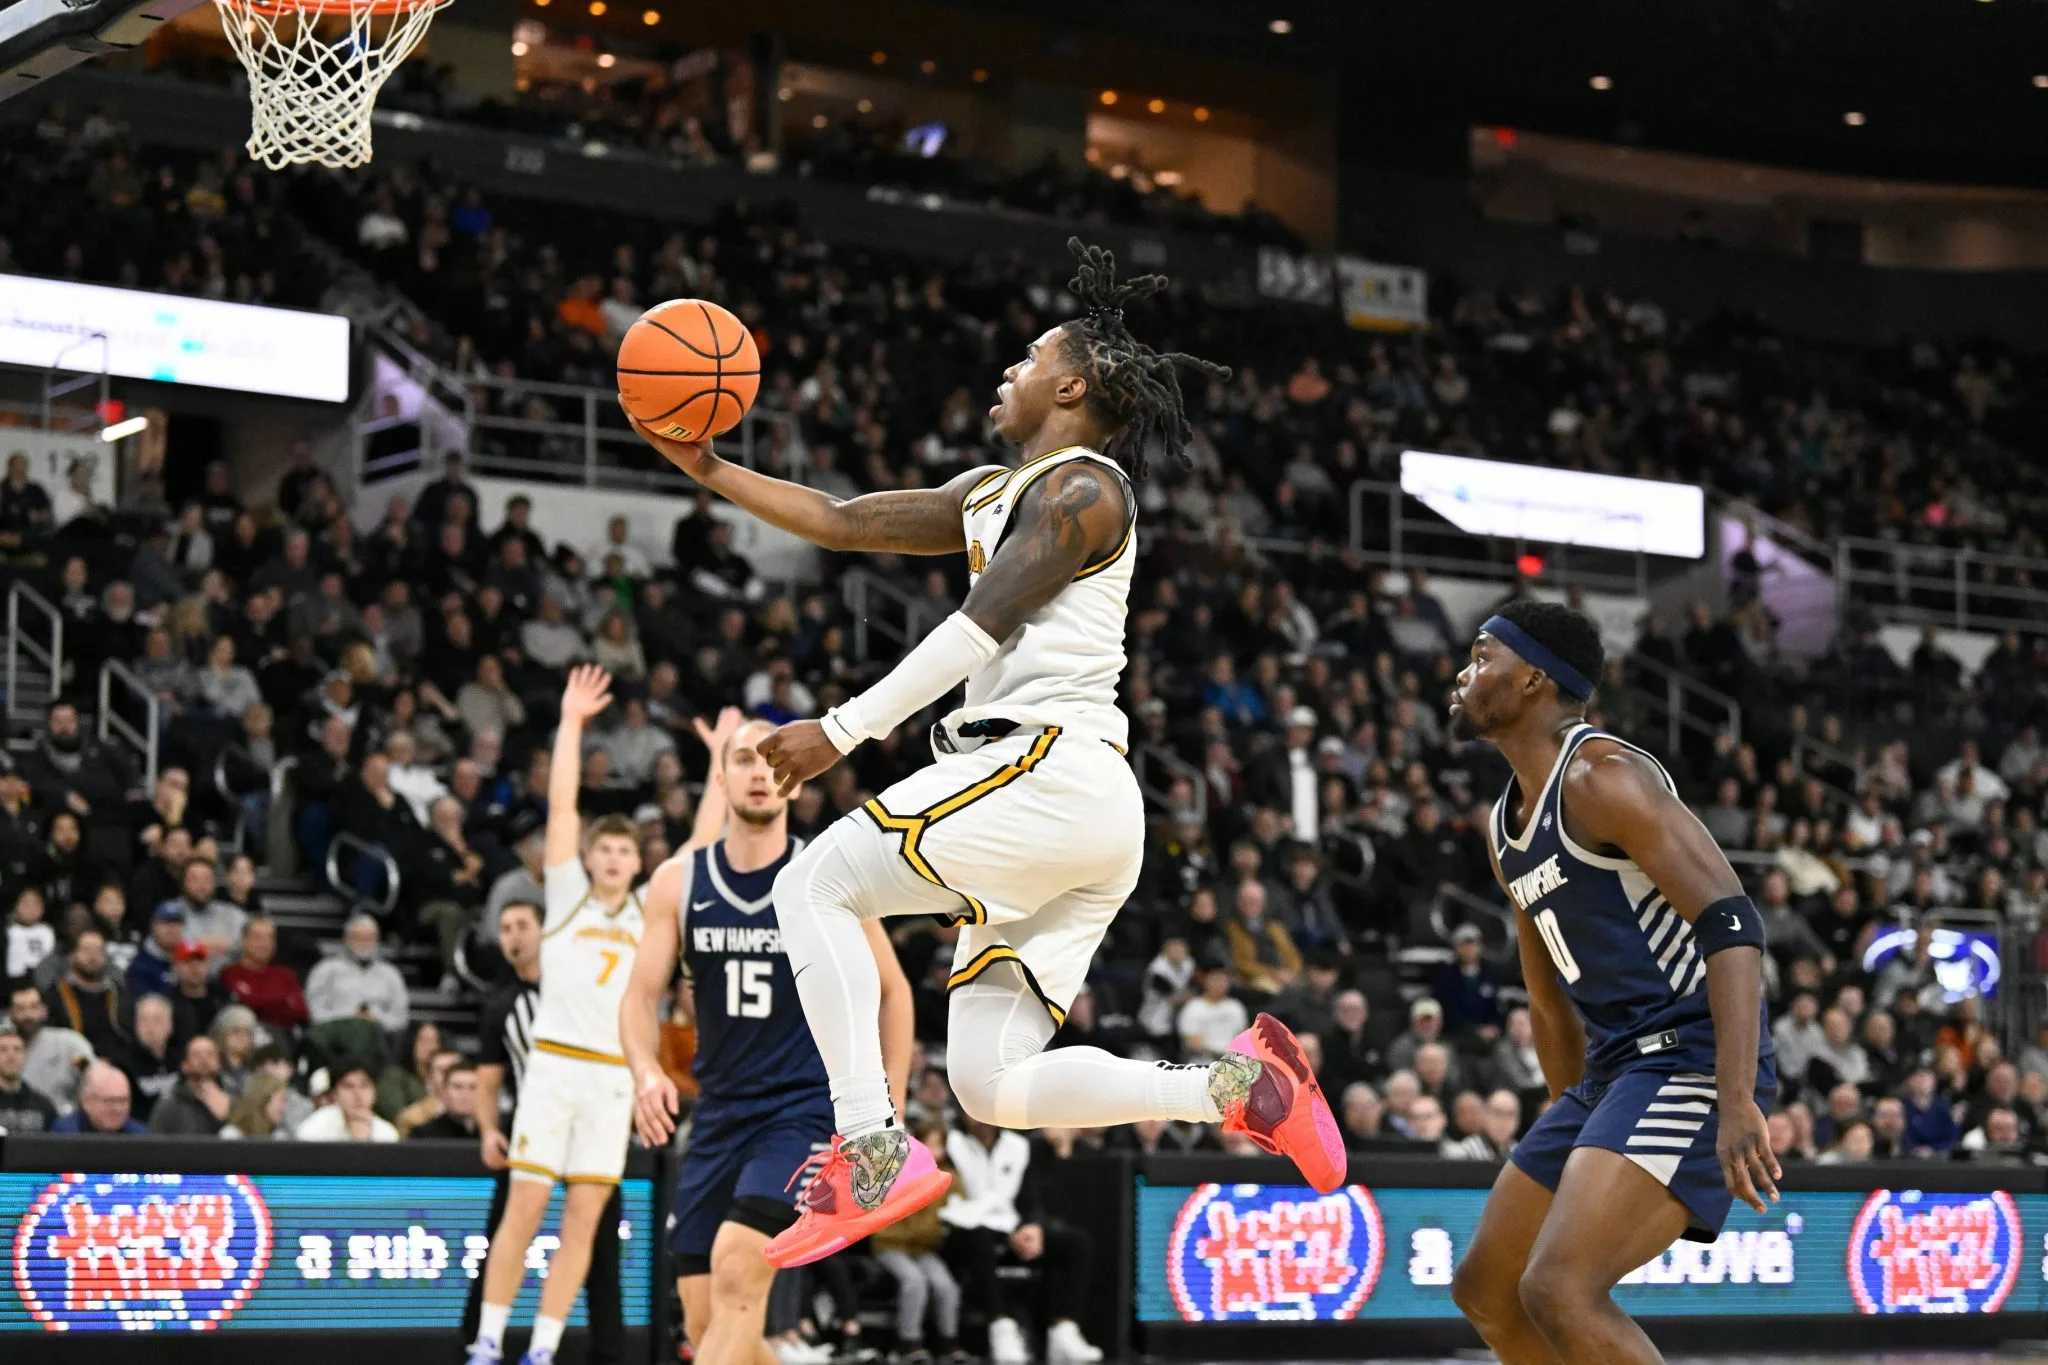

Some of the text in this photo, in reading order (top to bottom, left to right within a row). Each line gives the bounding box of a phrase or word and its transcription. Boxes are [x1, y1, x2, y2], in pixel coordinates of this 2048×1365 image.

[1521, 853, 1569, 905] HAMPSHIRE
[692, 926, 788, 954] NEW HAMPSH
[595, 948, 622, 987] 7
[724, 959, 774, 1019] 15
[1664, 1034, 1673, 1044] L
[296, 1235, 332, 1279] a
[347, 1226, 449, 1279] sub
